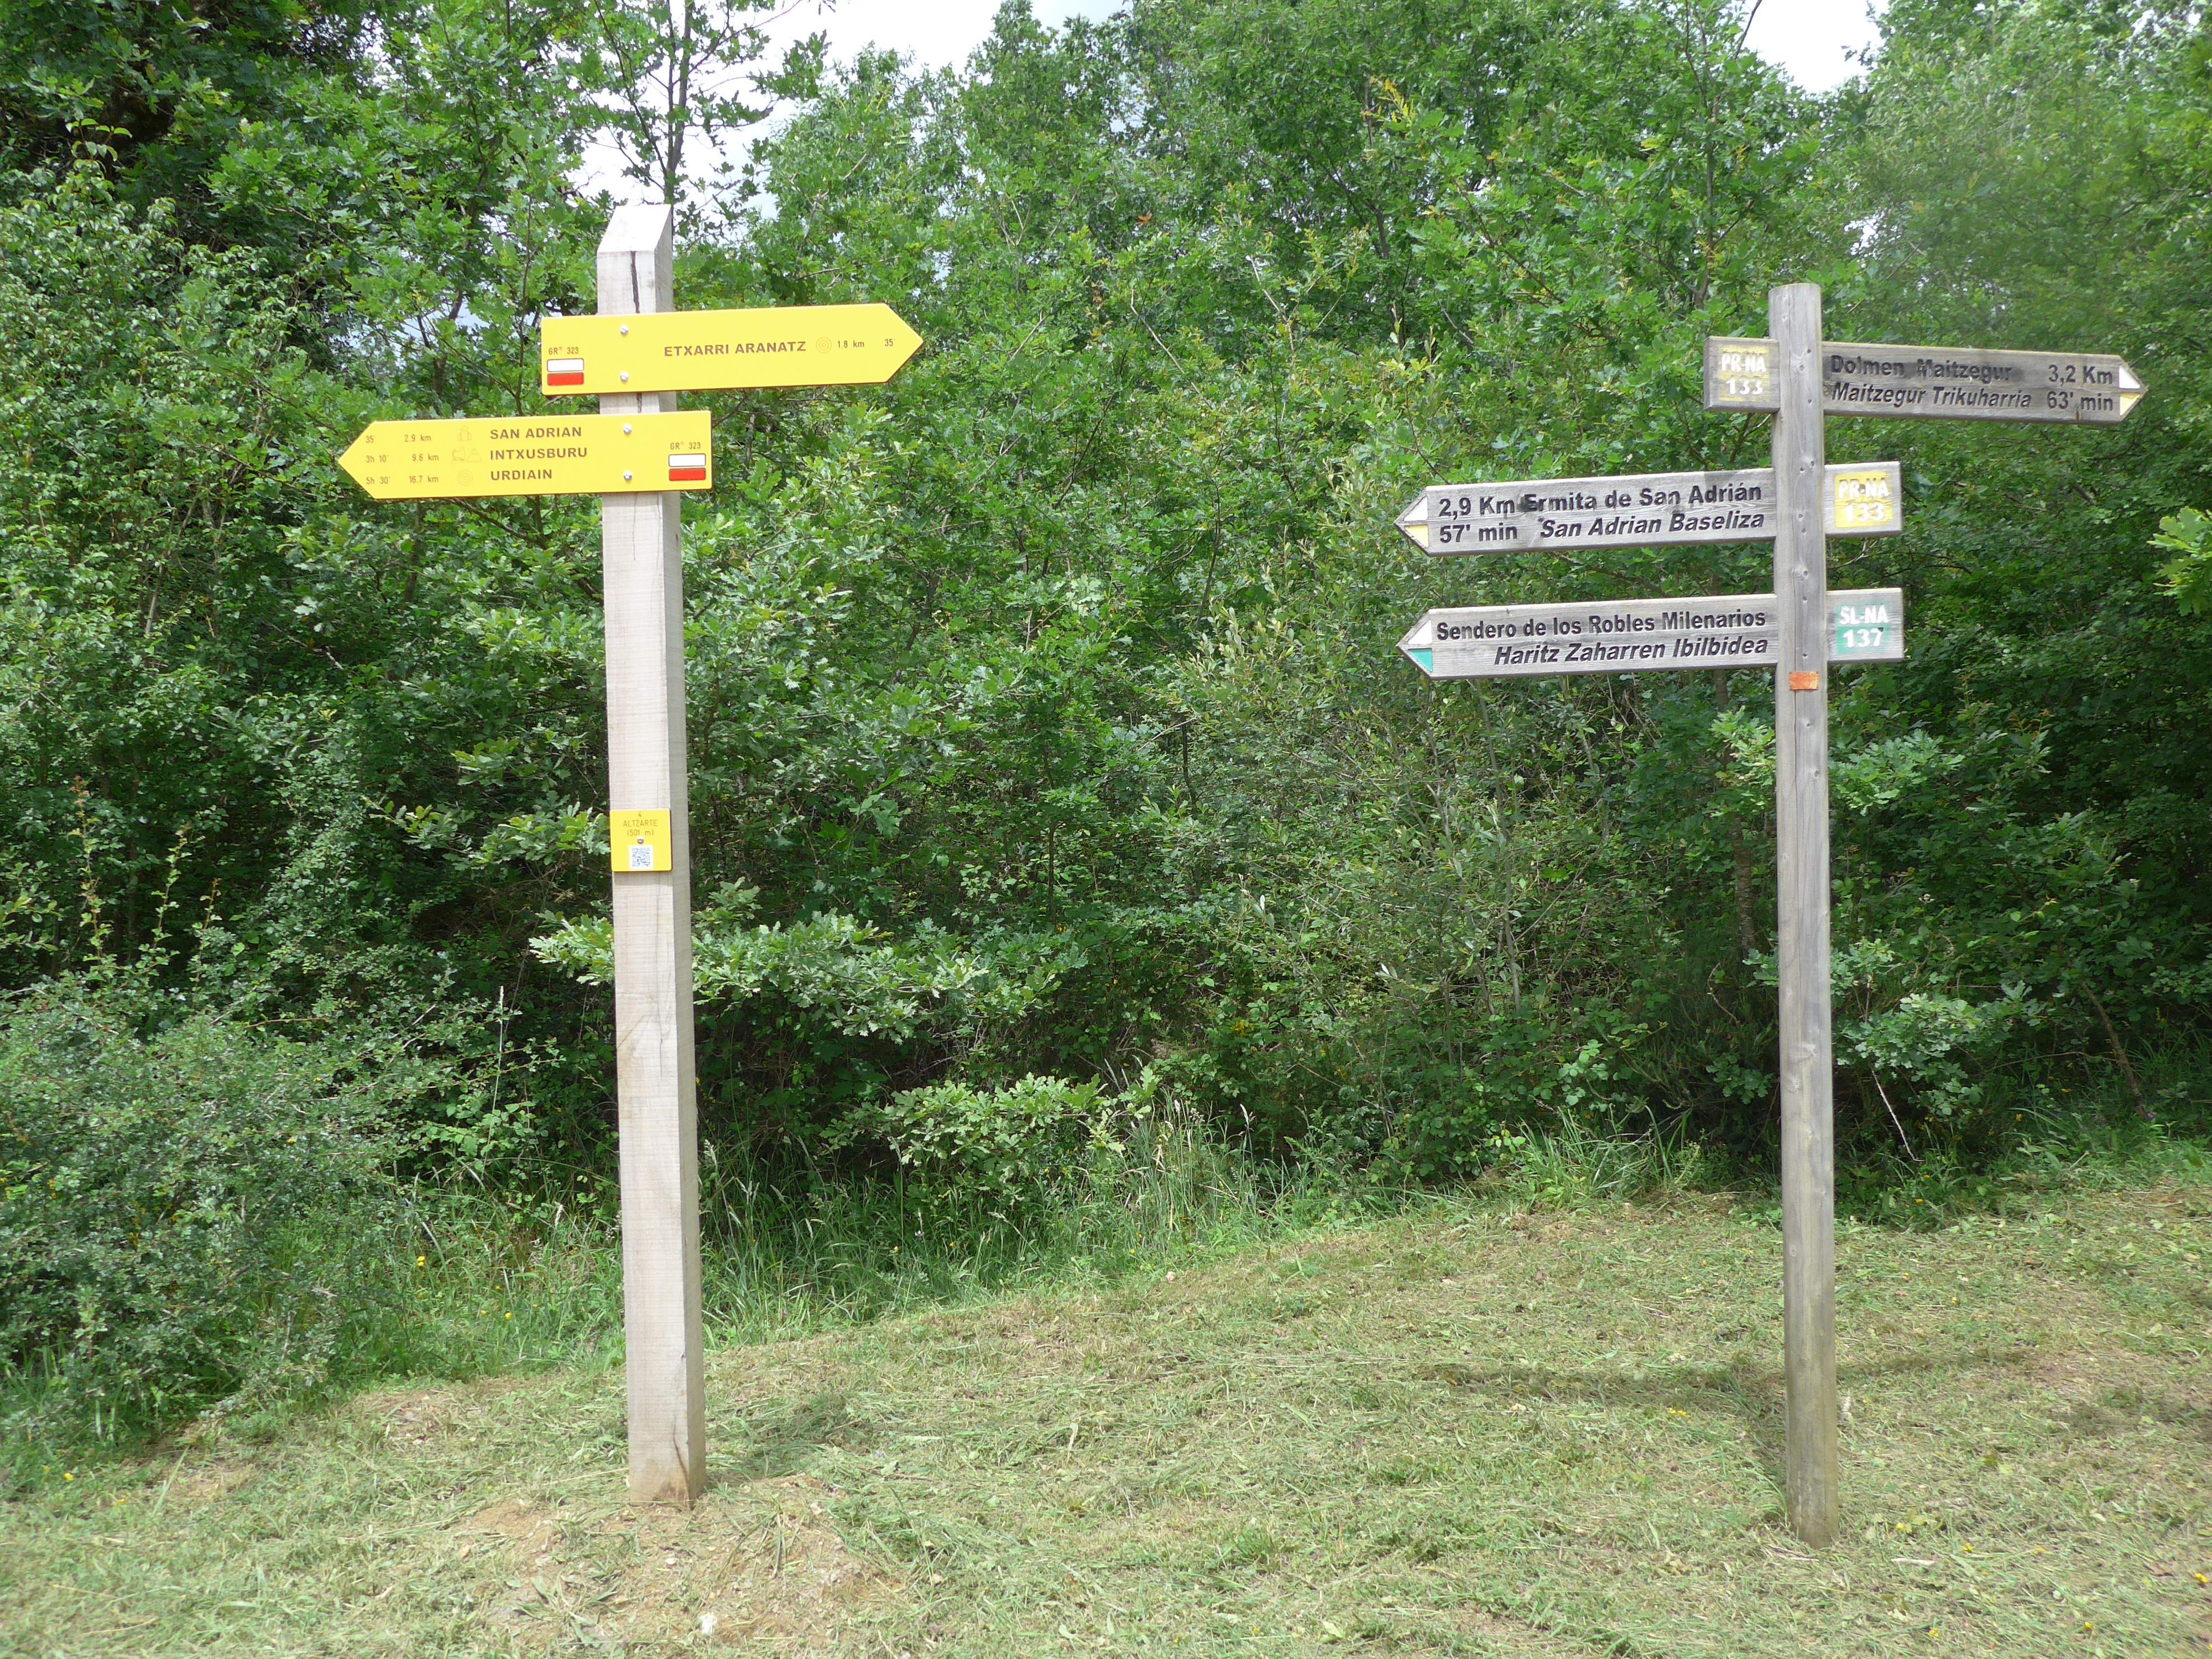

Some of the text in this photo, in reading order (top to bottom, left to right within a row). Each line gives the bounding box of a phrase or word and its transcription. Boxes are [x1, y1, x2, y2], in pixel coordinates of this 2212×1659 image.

[664, 344, 729, 357] ETXARRI
[734, 341, 806, 354] ARANATZ
[837, 340, 848, 349] 1.8
[853, 340, 865, 348] km
[1830, 355, 2112, 387] Dolmen Maitzegur 3,2 Km
[1725, 375, 1763, 395] 133
[1832, 382, 2114, 411] Maitzegur Trikuharria 63' min
[490, 429, 519, 440] SAN
[525, 426, 582, 439] ADRIAN
[428, 453, 439, 461] km
[490, 447, 587, 460] INTXUSBURU
[688, 441, 701, 450] 323
[491, 469, 552, 481] URDIAIN
[1839, 477, 1890, 499] PR-NA
[1439, 482, 1761, 520] 2,9 Km Ermita de San Adrián
[1844, 501, 1885, 523] 133
[1439, 510, 1765, 543] 57' min San Adrian Baseliza
[1438, 609, 1766, 641] Sendero de los Robles Milenarios
[1840, 603, 1890, 625] SL-NA
[1843, 627, 1884, 648] 137
[1494, 636, 1768, 665] Haritz Zaharren Ibilbidea
[623, 819, 658, 827] ALTZARTE
